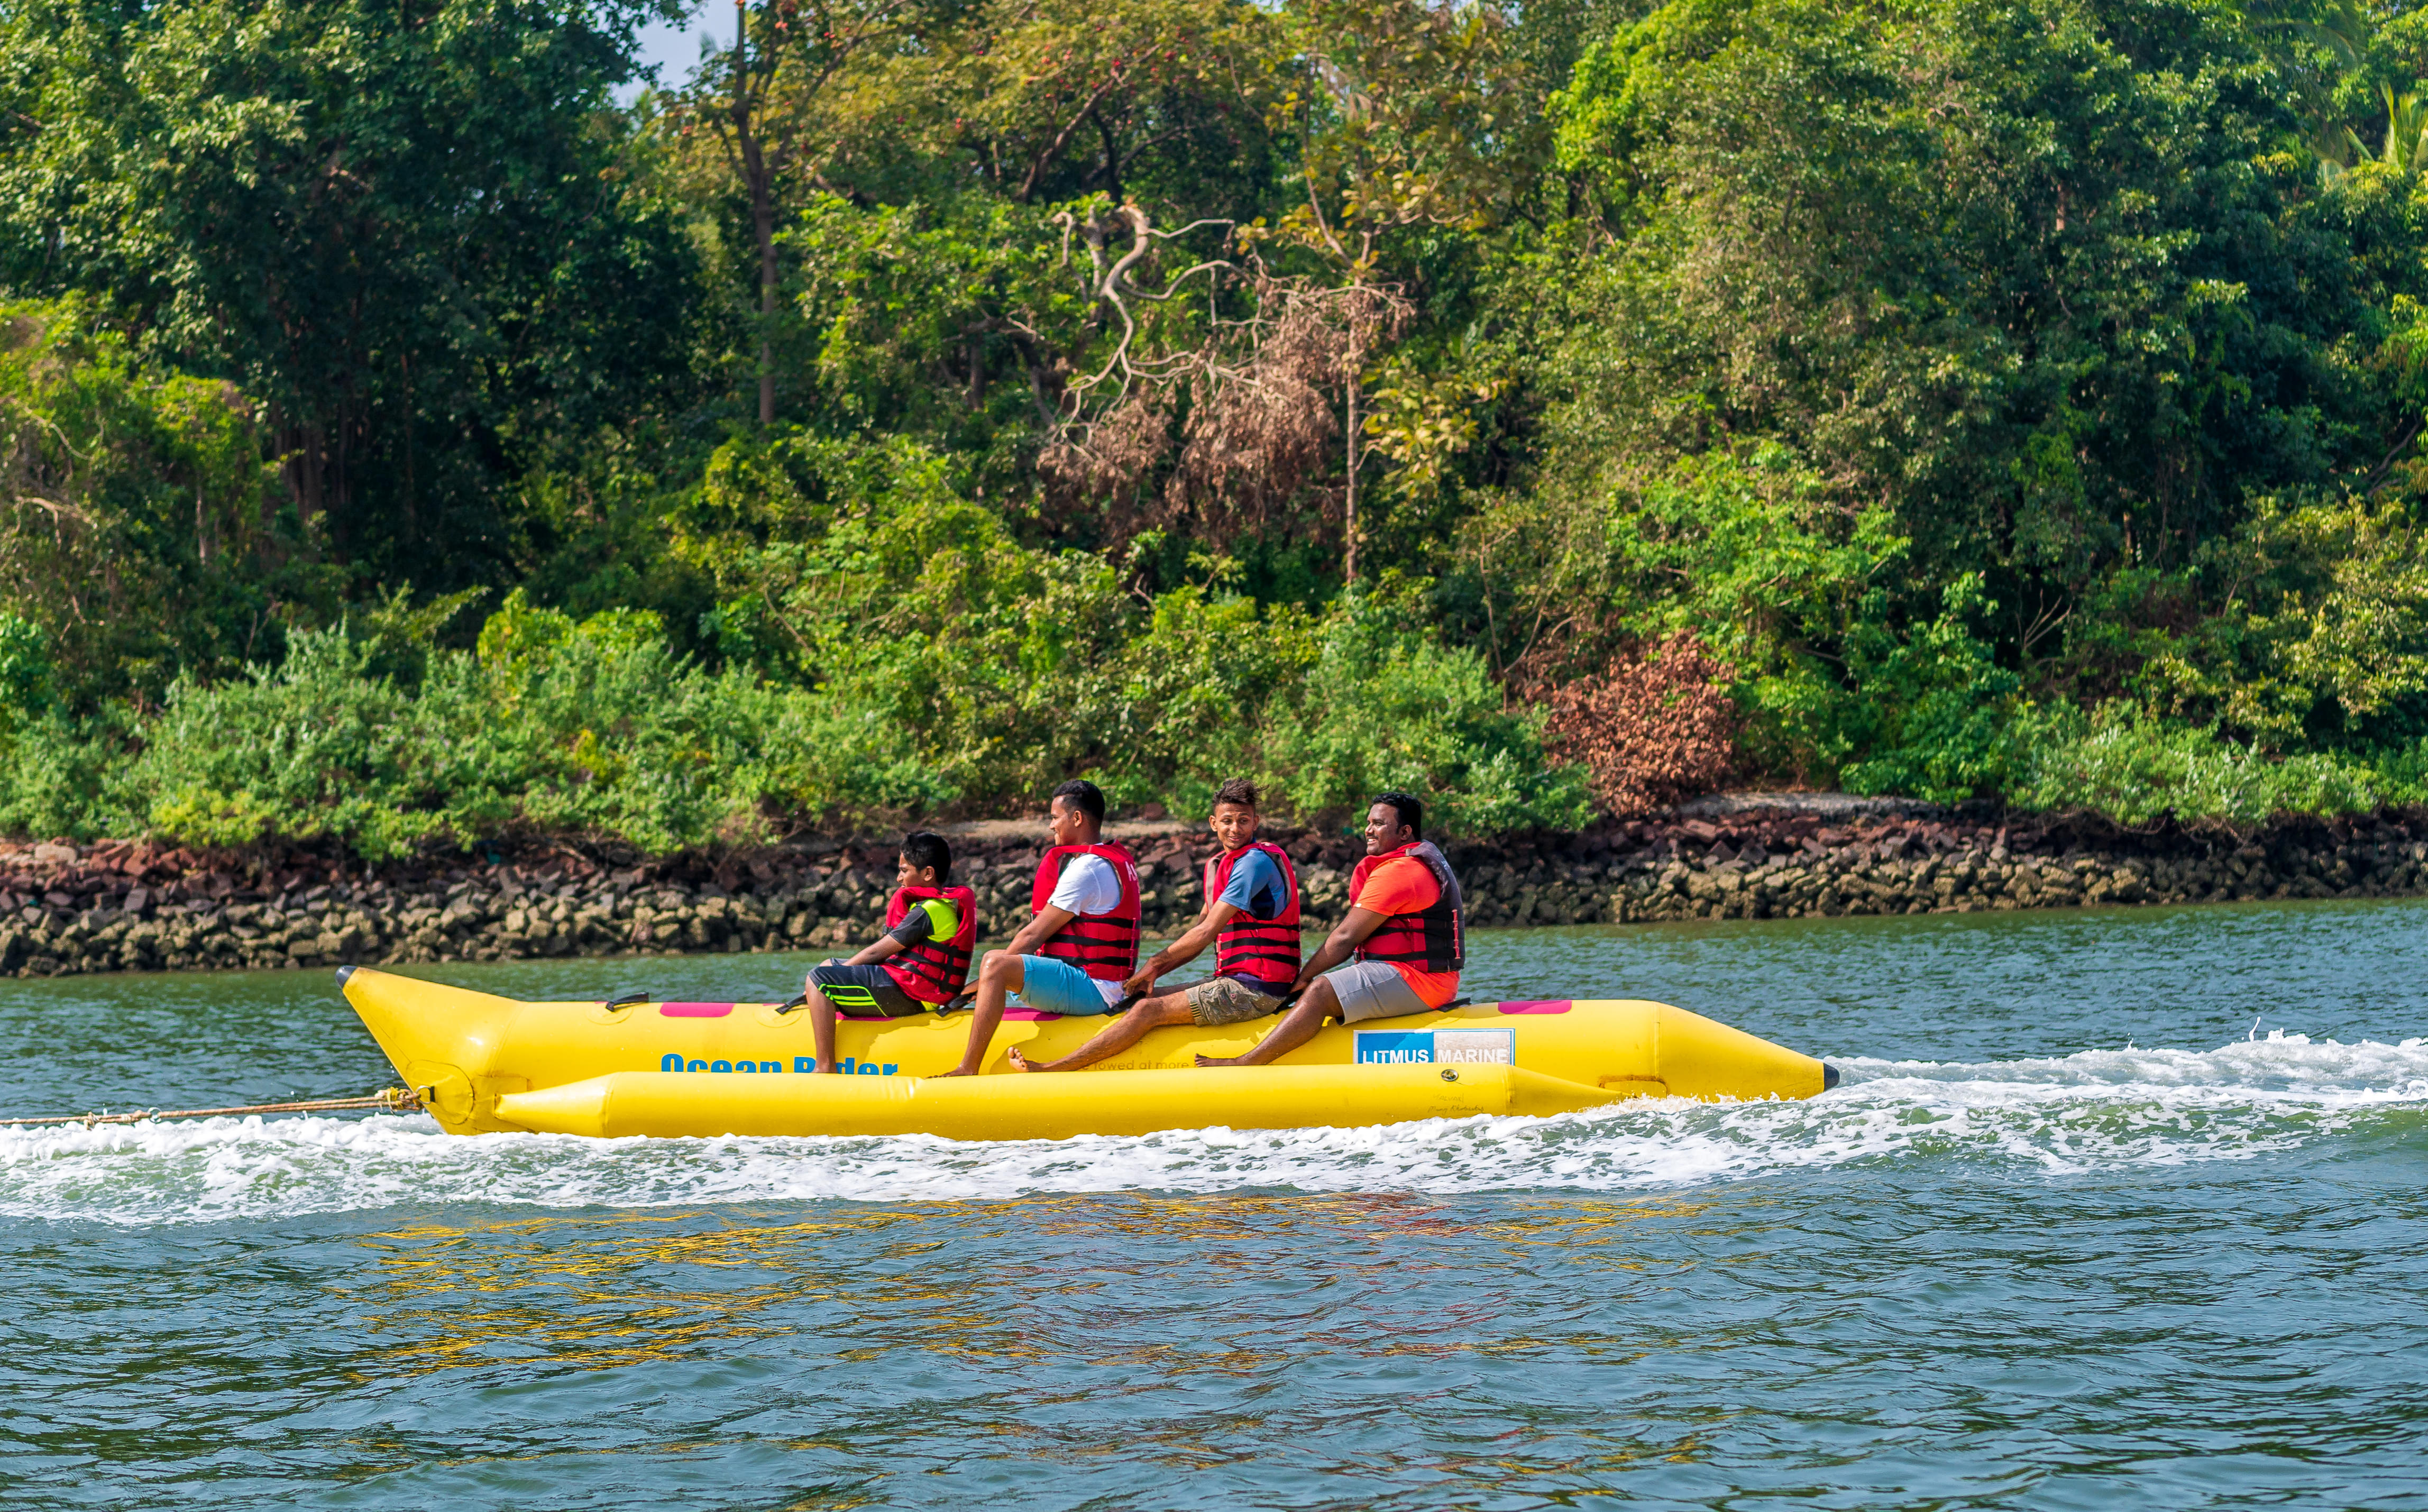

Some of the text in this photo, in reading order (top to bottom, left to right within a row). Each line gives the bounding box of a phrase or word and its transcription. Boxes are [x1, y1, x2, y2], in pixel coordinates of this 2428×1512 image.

[1362, 1049, 1508, 1064] LITMUS MARINE
[794, 1056, 898, 1075] Rder
[1139, 1060, 1151, 1069] at
